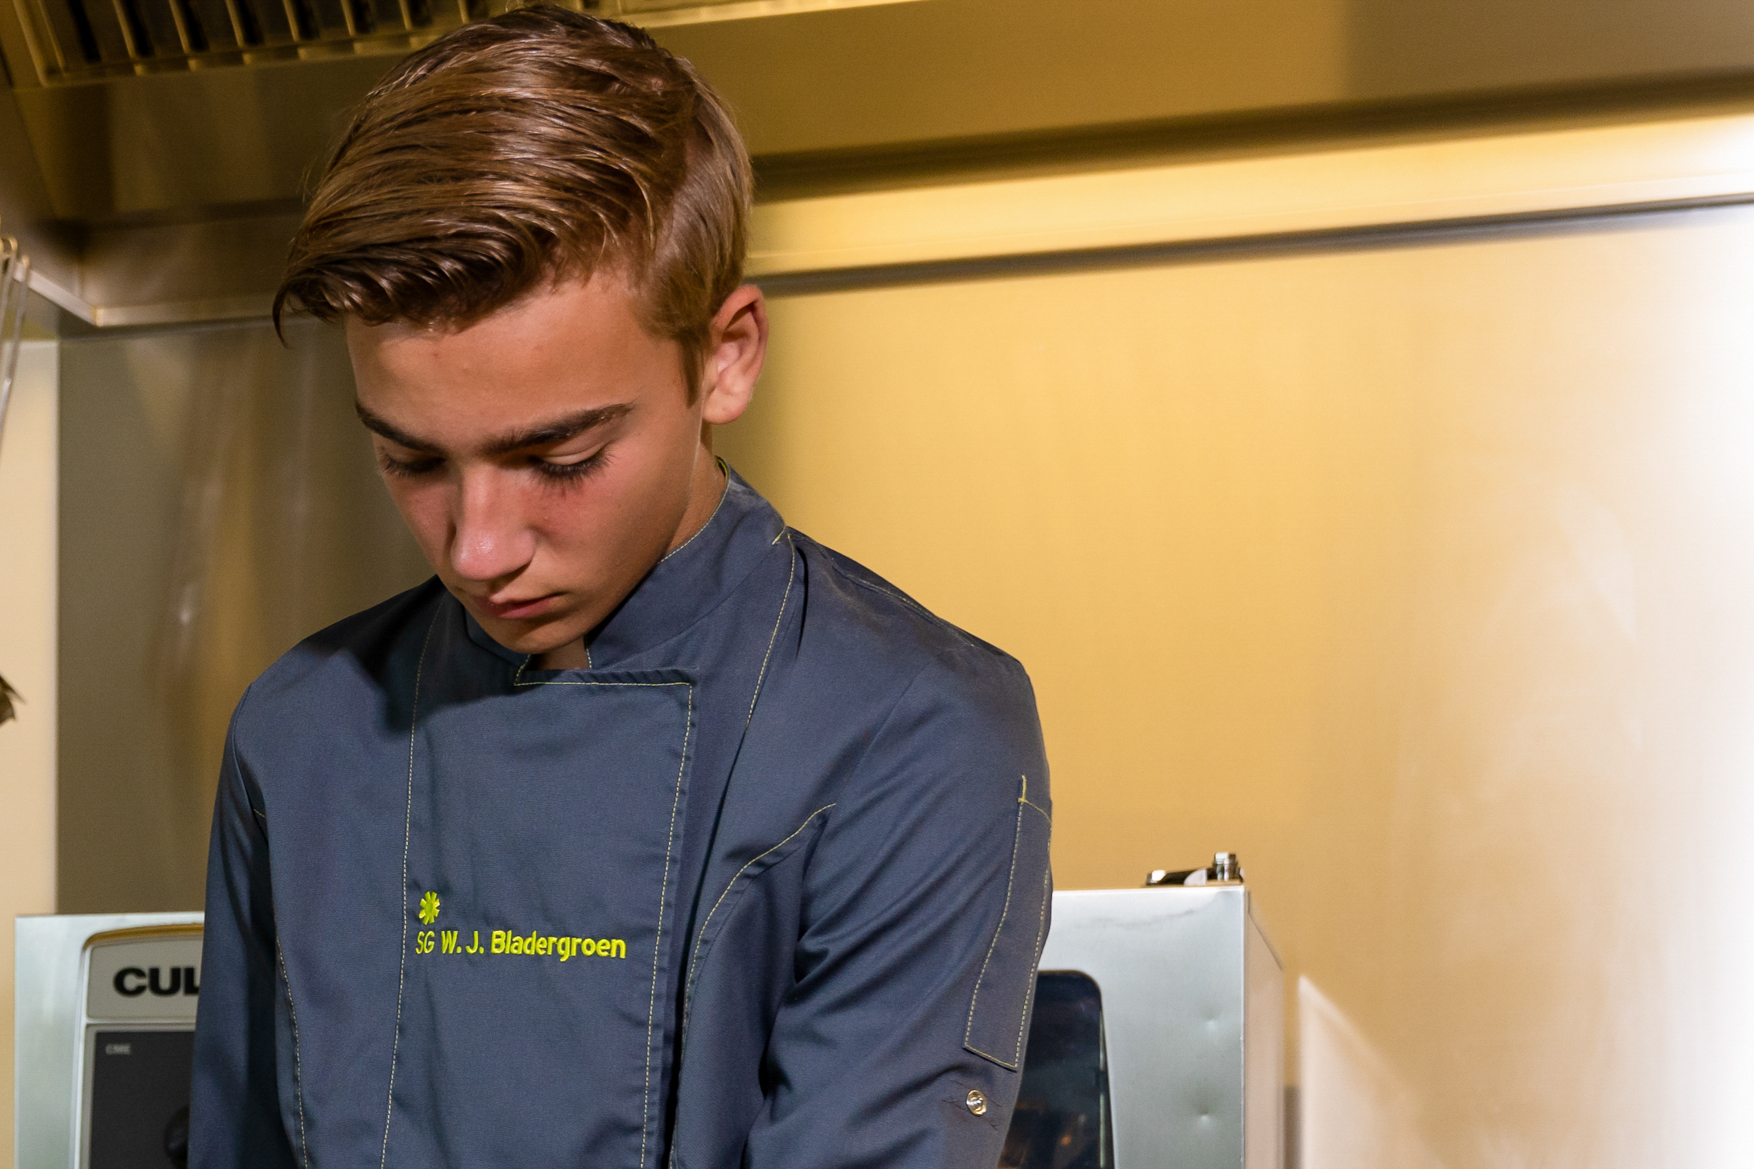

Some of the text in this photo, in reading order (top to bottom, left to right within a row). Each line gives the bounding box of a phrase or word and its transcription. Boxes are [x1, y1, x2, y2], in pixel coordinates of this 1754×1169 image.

[415, 930, 626, 962] SG W. J. Bladergroen
